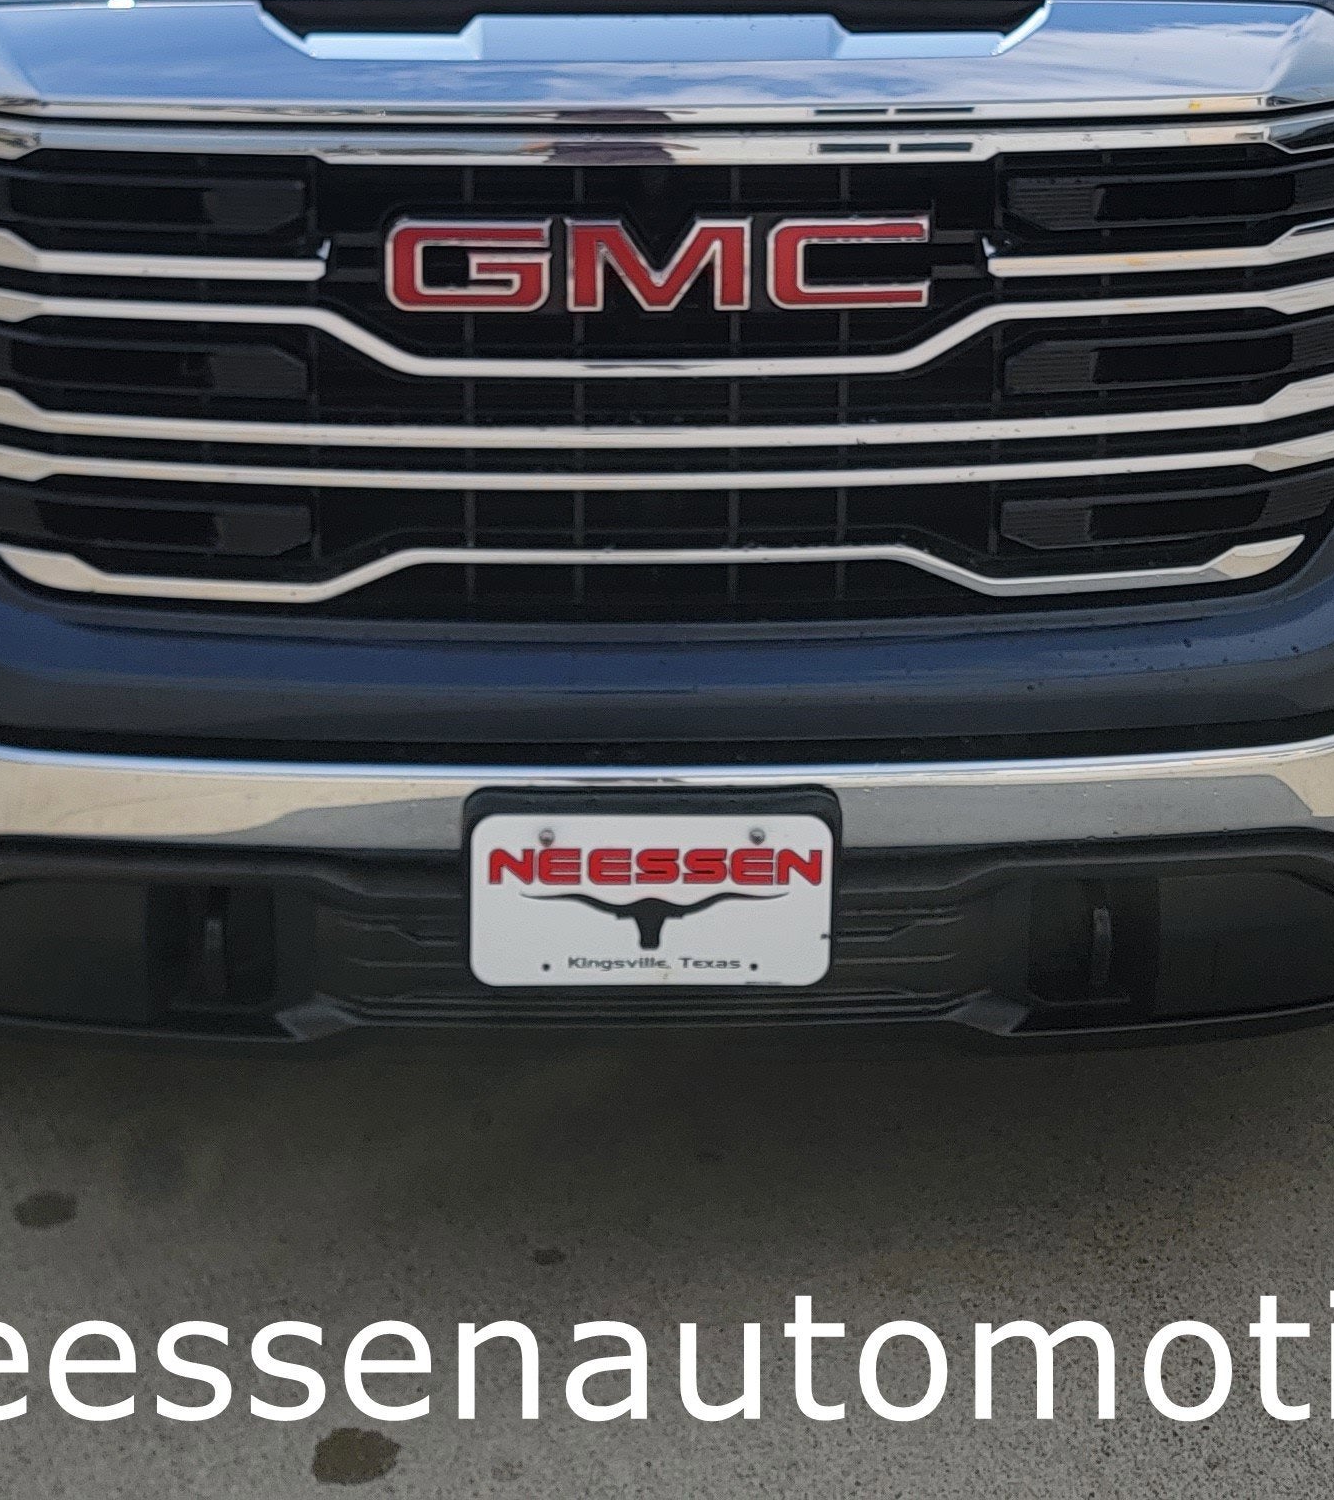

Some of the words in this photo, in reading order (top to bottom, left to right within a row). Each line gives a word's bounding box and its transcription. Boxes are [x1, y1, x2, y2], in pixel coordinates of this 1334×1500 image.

[385, 216, 930, 312] GMC
[487, 847, 822, 885] NEESSEN
[679, 957, 741, 969] Texas
